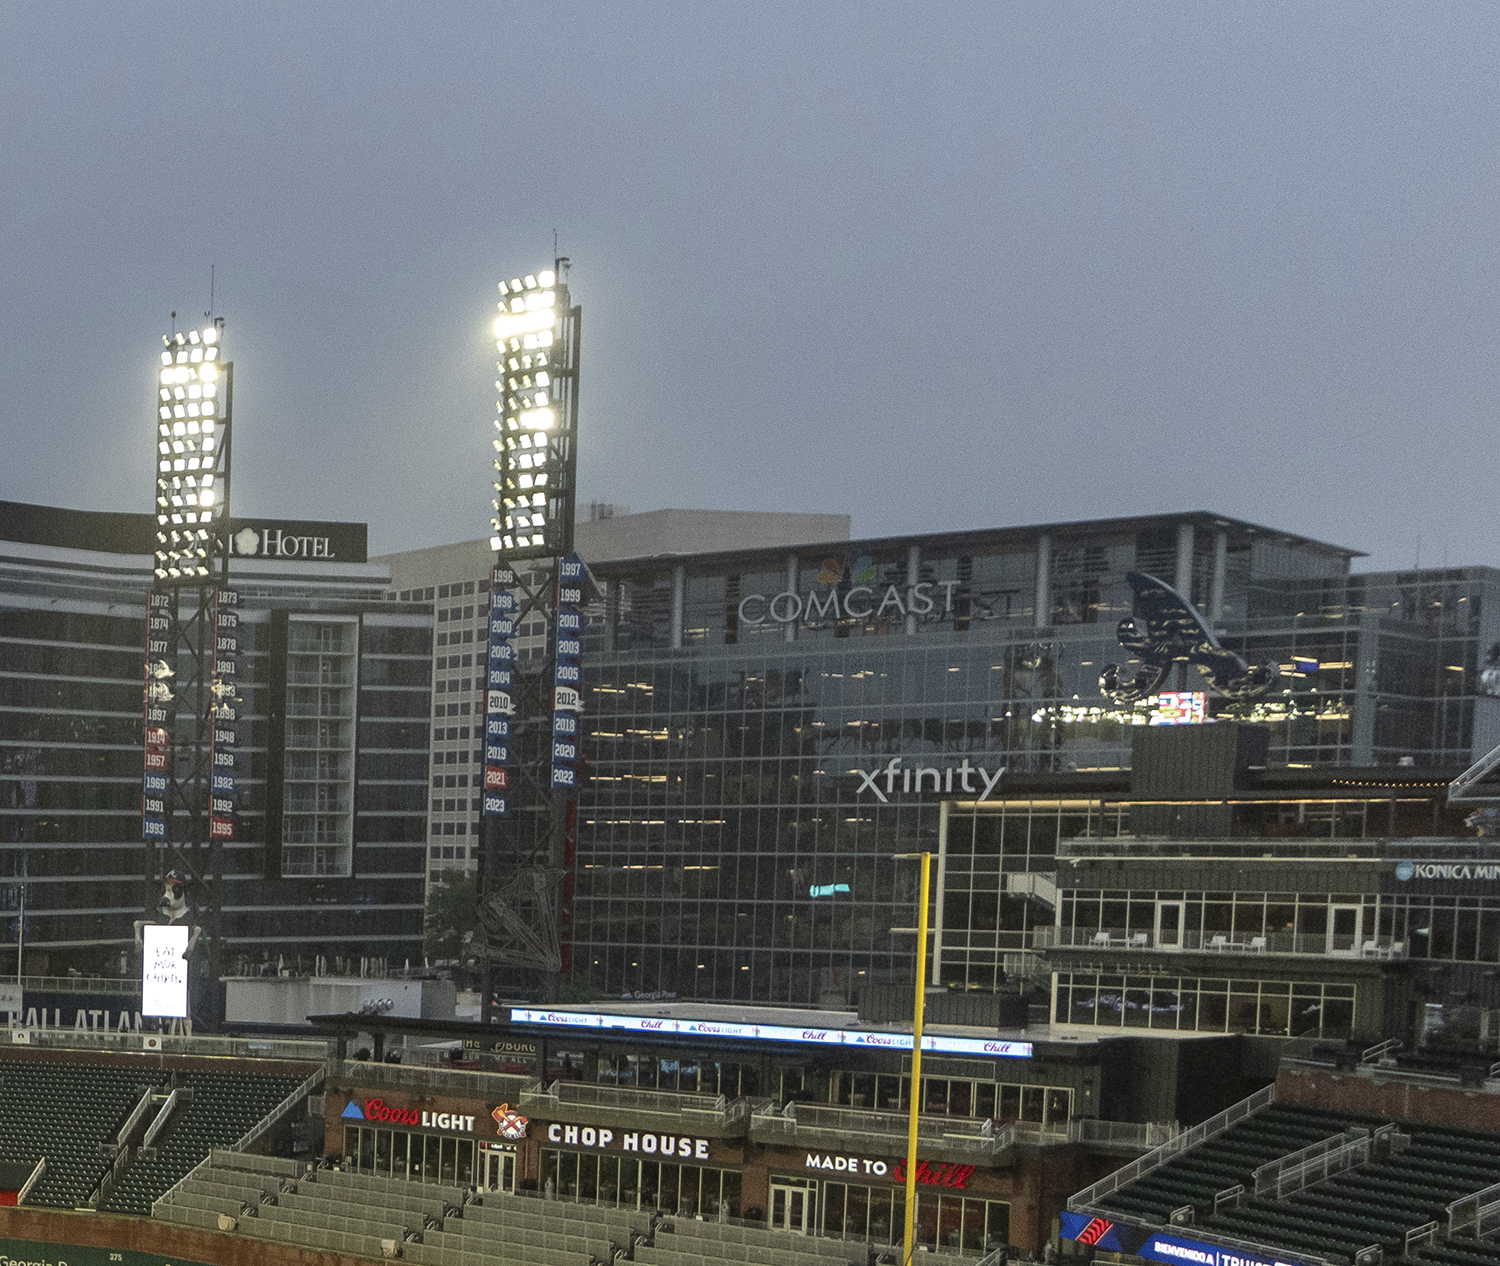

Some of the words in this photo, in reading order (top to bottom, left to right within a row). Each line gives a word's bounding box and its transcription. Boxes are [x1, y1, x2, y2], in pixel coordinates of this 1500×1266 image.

[262, 529, 335, 558] HOTEL
[493, 569, 514, 583] 1996
[561, 562, 581, 576] 1997
[150, 594, 168, 607] 1872
[218, 591, 238, 603] 1873
[492, 594, 512, 608] 1998
[560, 588, 580, 602] 1999
[738, 580, 961, 624] COMCAST
[150, 618, 168, 631] 1874
[217, 615, 236, 627] 1875
[492, 620, 512, 633] 2000
[559, 614, 579, 628] 2001
[149, 640, 167, 653] 1877
[491, 645, 511, 659] 2002
[558, 640, 579, 654] 2003
[216, 661, 235, 674] 1891
[557, 666, 578, 680] 2005
[490, 670, 510, 685] 2004
[489, 695, 508, 709] 2010
[556, 692, 576, 705] 2012
[148, 708, 167, 721] 1897
[488, 721, 508, 735] 2013
[555, 718, 575, 732] 2018
[214, 730, 235, 742] 1948
[487, 746, 506, 760] 2019
[554, 743, 575, 758] 2020
[146, 754, 165, 767] 1957
[214, 753, 234, 766] 1958
[146, 777, 166, 789] 1969
[213, 776, 234, 789] 1982
[486, 771, 505, 785] 2021
[553, 769, 574, 784] 2022
[856, 757, 1007, 803] xfinity
[145, 799, 164, 812] 1991
[212, 799, 233, 812] 1992
[485, 797, 505, 812] 2023
[145, 822, 164, 835] 1993
[212, 821, 232, 835] 1995
[365, 1098, 422, 1126] Coors
[421, 1110, 475, 1132] LIGHT
[547, 1123, 614, 1148] CHOP
[623, 1132, 710, 1159] HOUSE
[805, 1153, 859, 1173] MADE
[863, 1159, 888, 1176] TO
[108, 1252, 122, 1262] 375
[1153, 1241, 1206, 1262] BIENVENIDO
[1205, 1253, 1215, 1265] A
